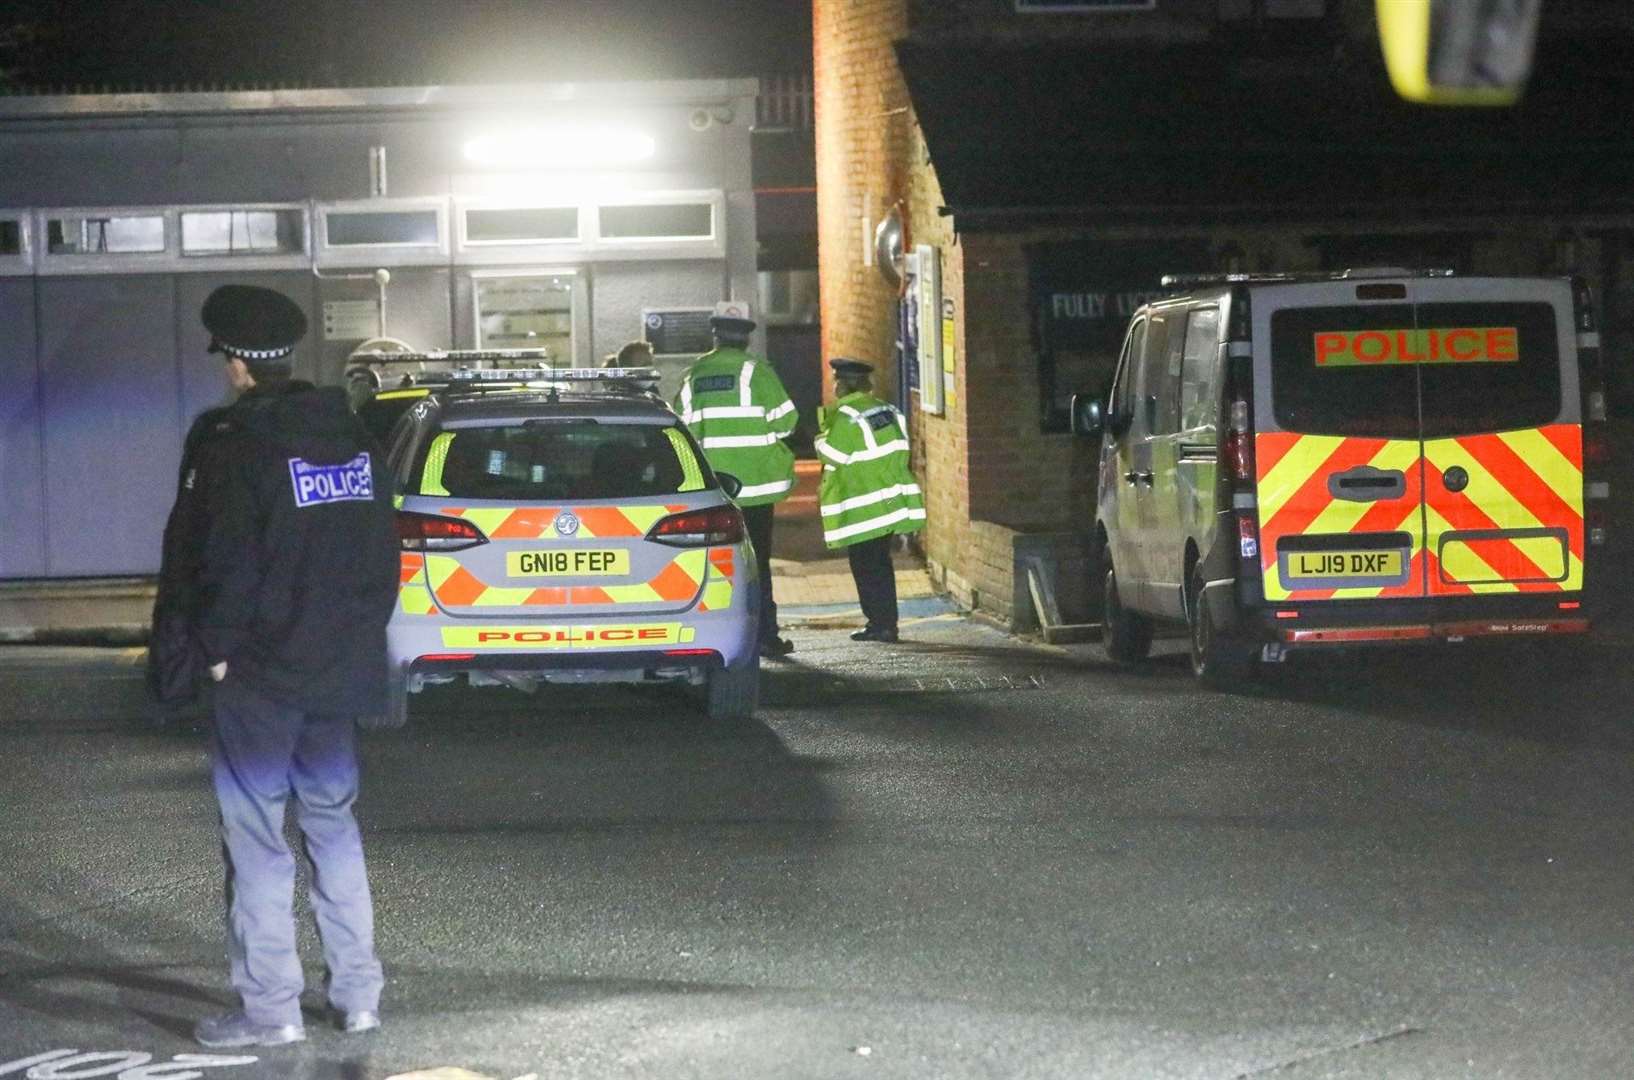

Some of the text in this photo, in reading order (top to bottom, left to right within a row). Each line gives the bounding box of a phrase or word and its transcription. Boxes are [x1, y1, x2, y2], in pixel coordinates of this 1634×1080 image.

[1052, 293, 1106, 319] FULLY
[1315, 329, 1516, 364] POLICE
[299, 470, 370, 501] POLICE
[520, 552, 616, 573] GN18 FEP
[1301, 554, 1389, 574] LJ19 DXF
[478, 628, 668, 643] POLICE
